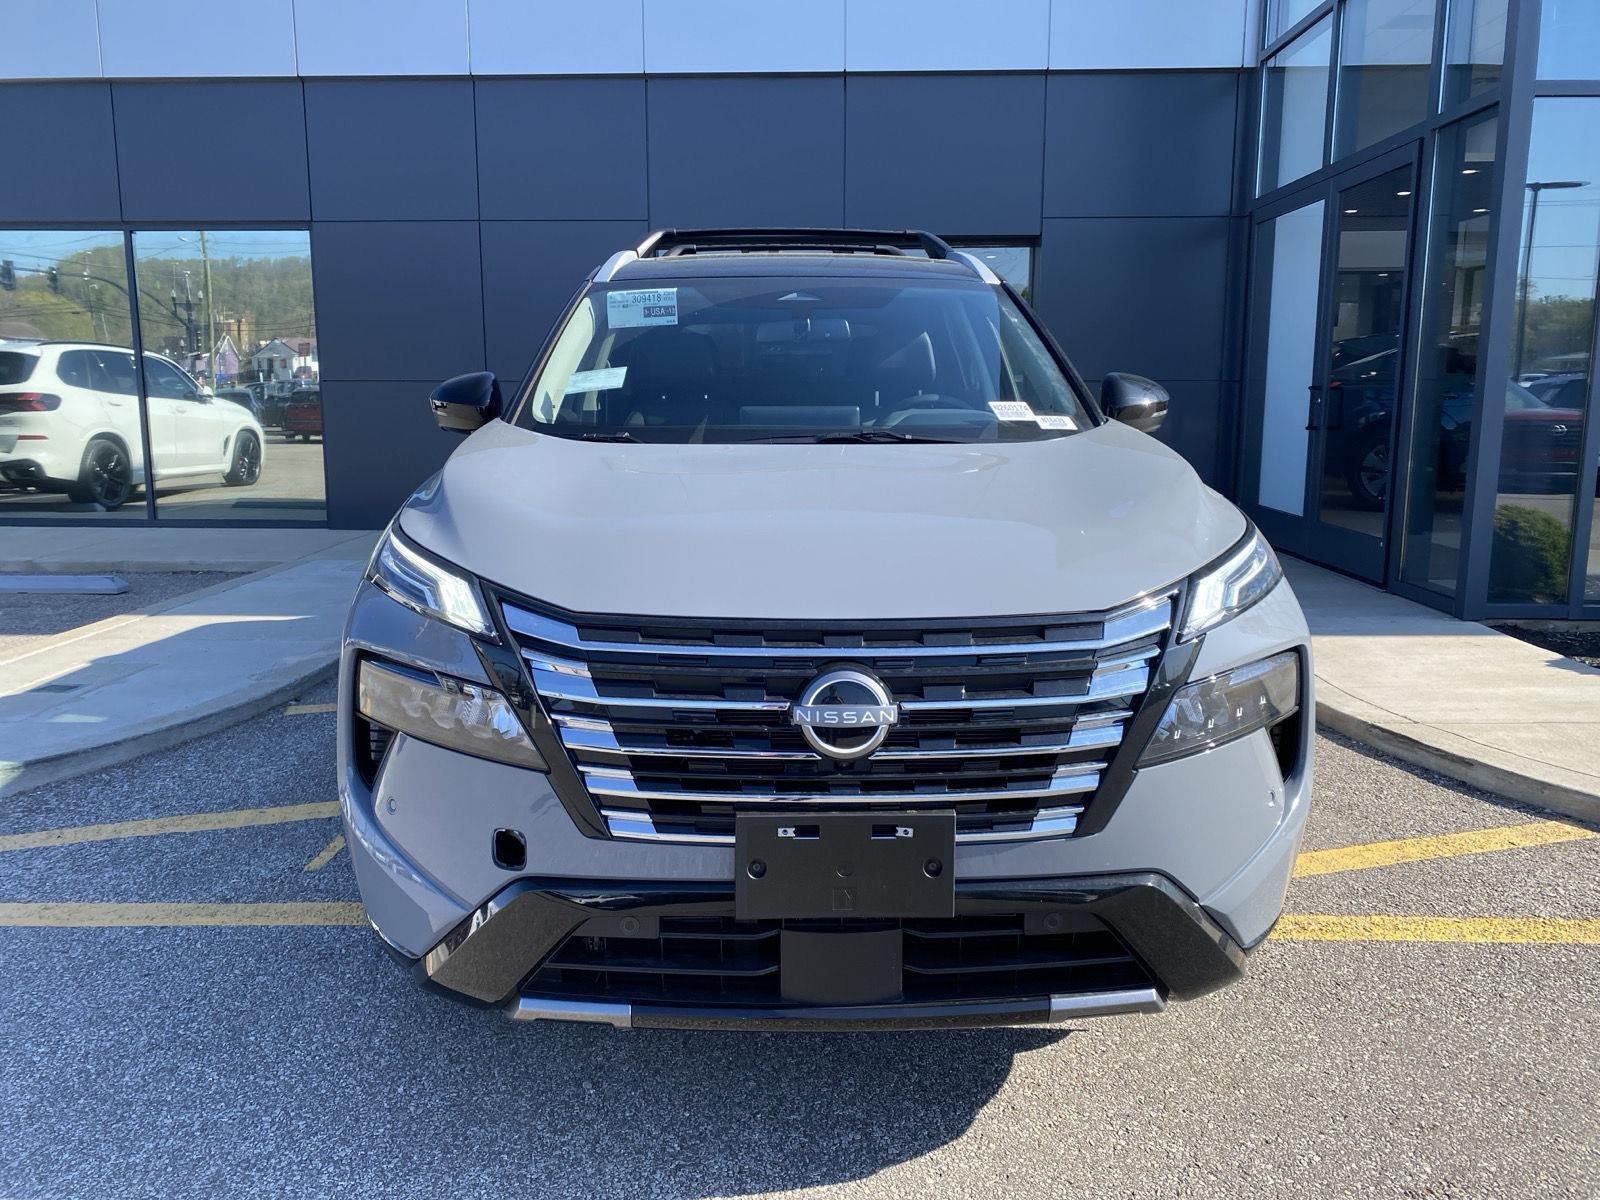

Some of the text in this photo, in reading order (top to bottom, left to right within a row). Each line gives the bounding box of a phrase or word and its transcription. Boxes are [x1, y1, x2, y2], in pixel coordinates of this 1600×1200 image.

[632, 294, 661, 303] 309418
[650, 307, 666, 316] USA
[796, 709, 894, 724] NISSAN
